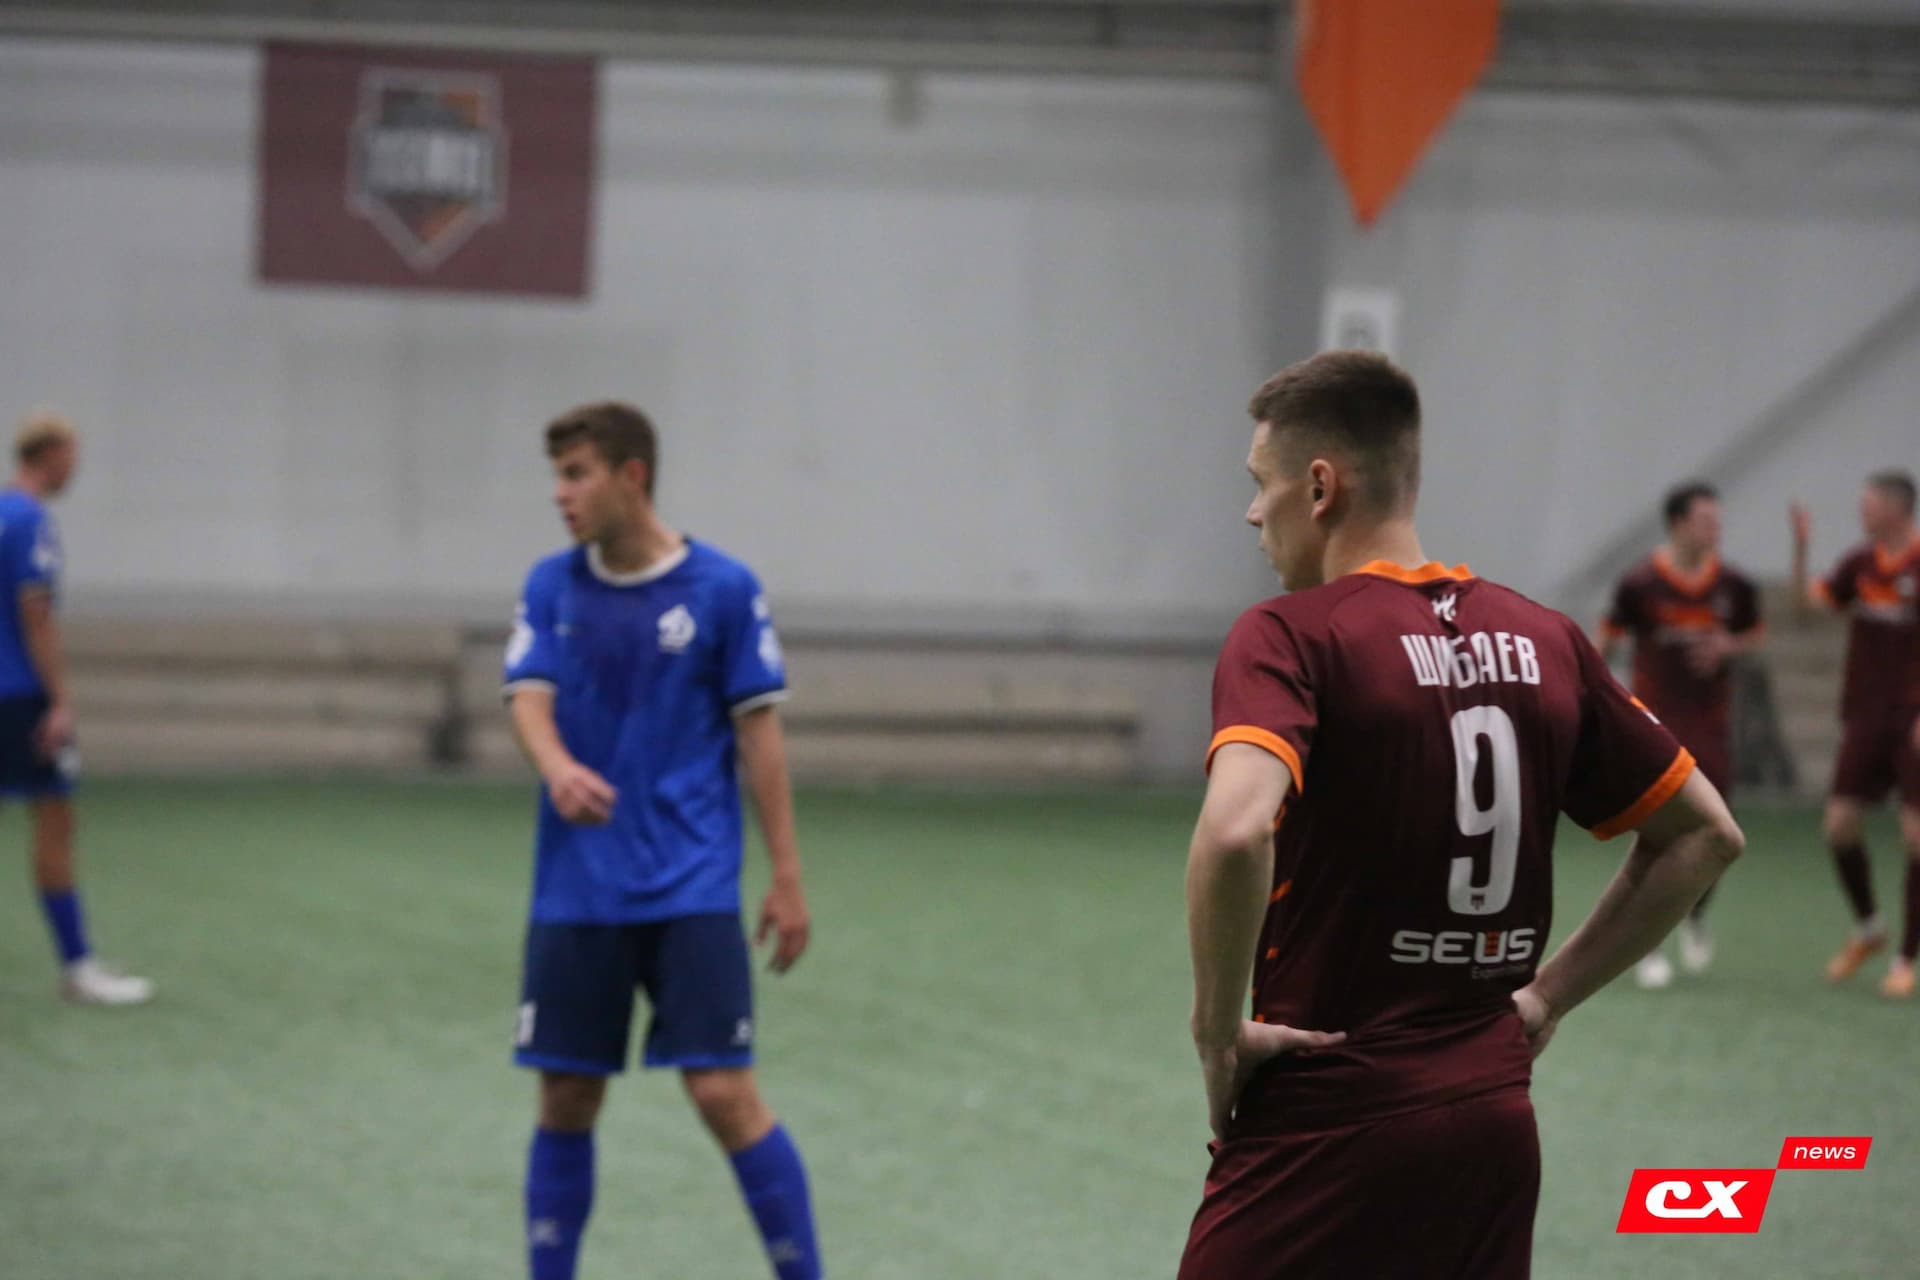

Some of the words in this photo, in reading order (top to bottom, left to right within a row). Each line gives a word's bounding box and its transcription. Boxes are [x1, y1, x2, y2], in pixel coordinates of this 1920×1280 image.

[1400, 631, 1541, 689] ШИБАЕВ
[1447, 704, 1521, 915] 9
[1390, 928, 1536, 964] SEUS
